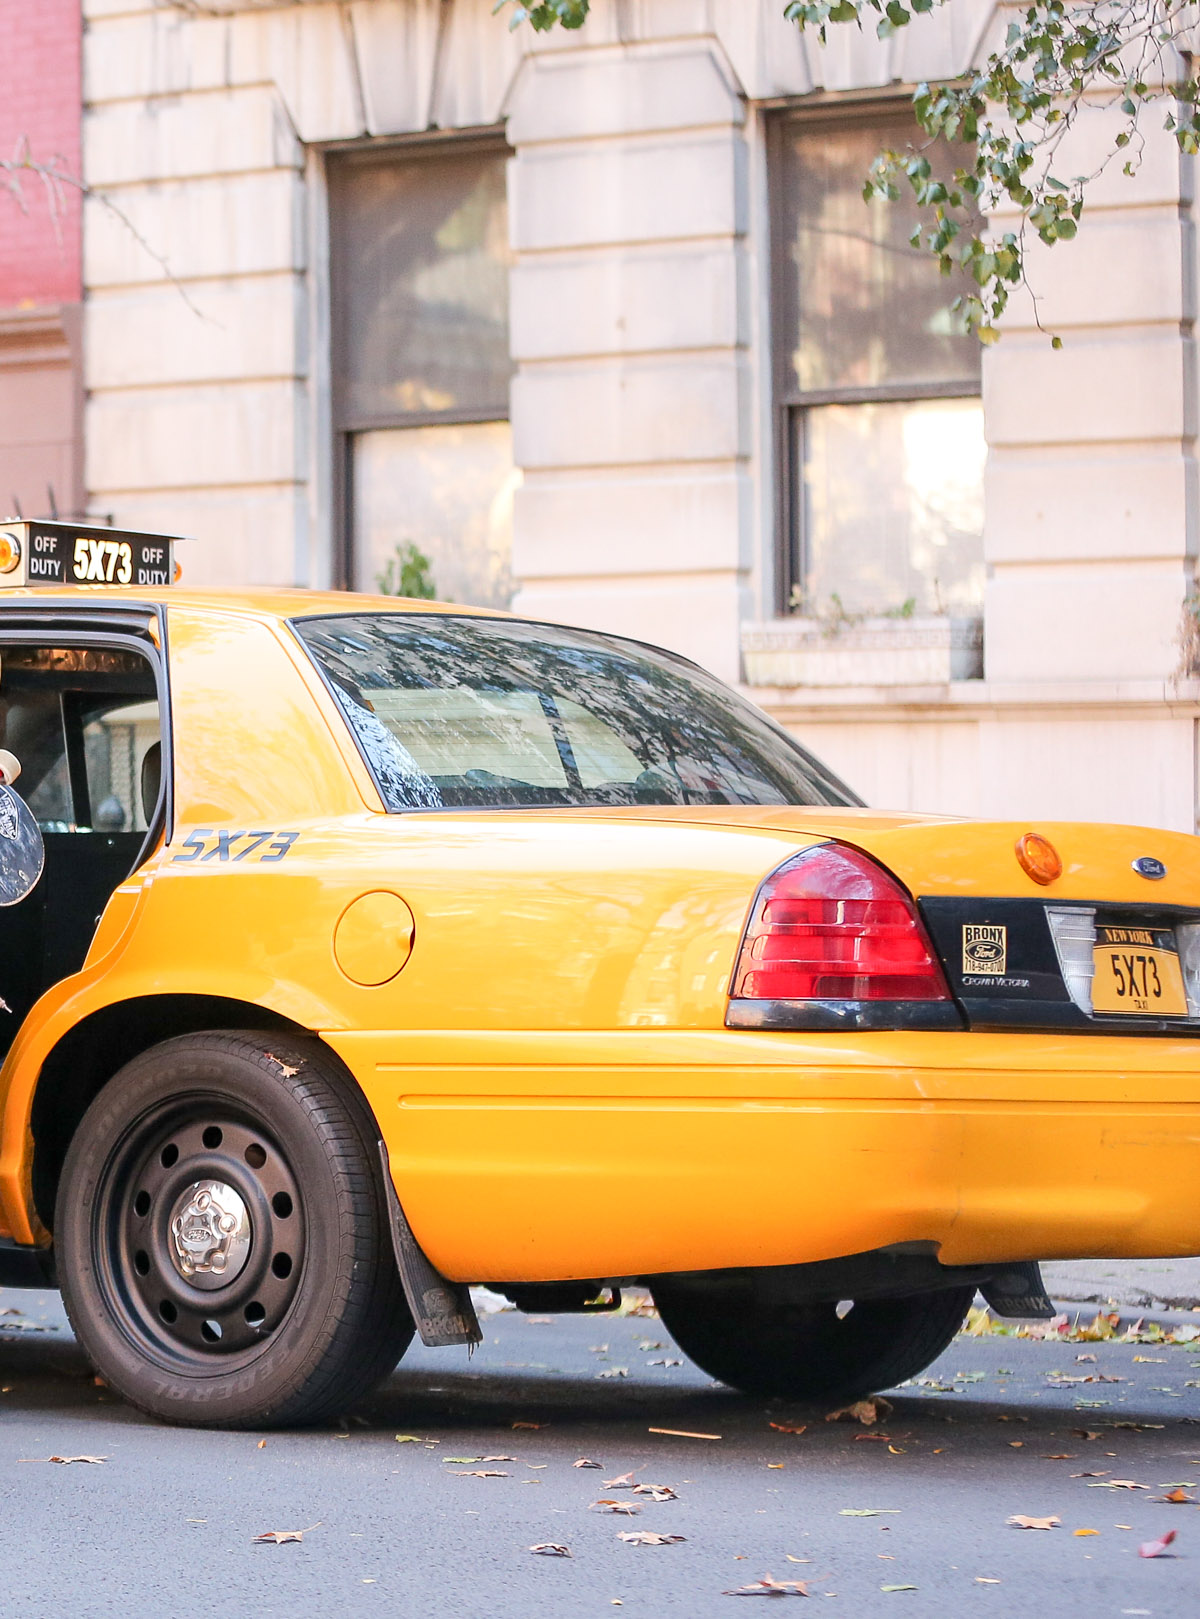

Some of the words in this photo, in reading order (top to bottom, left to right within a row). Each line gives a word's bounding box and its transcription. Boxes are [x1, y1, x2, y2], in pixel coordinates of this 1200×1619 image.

[34, 536, 58, 553] OFF
[72, 538, 132, 584] 5X73
[142, 547, 164, 564] OFF
[30, 557, 61, 576] DUTY
[138, 569, 168, 585] DUTY
[172, 829, 300, 861] 5X73
[965, 927, 1004, 946] BRONX
[1104, 928, 1127, 943] NEW
[1127, 929, 1154, 945] YORK
[974, 944, 997, 958] Ford
[1110, 954, 1162, 998] 5X73
[421, 1315, 469, 1337] BRON
